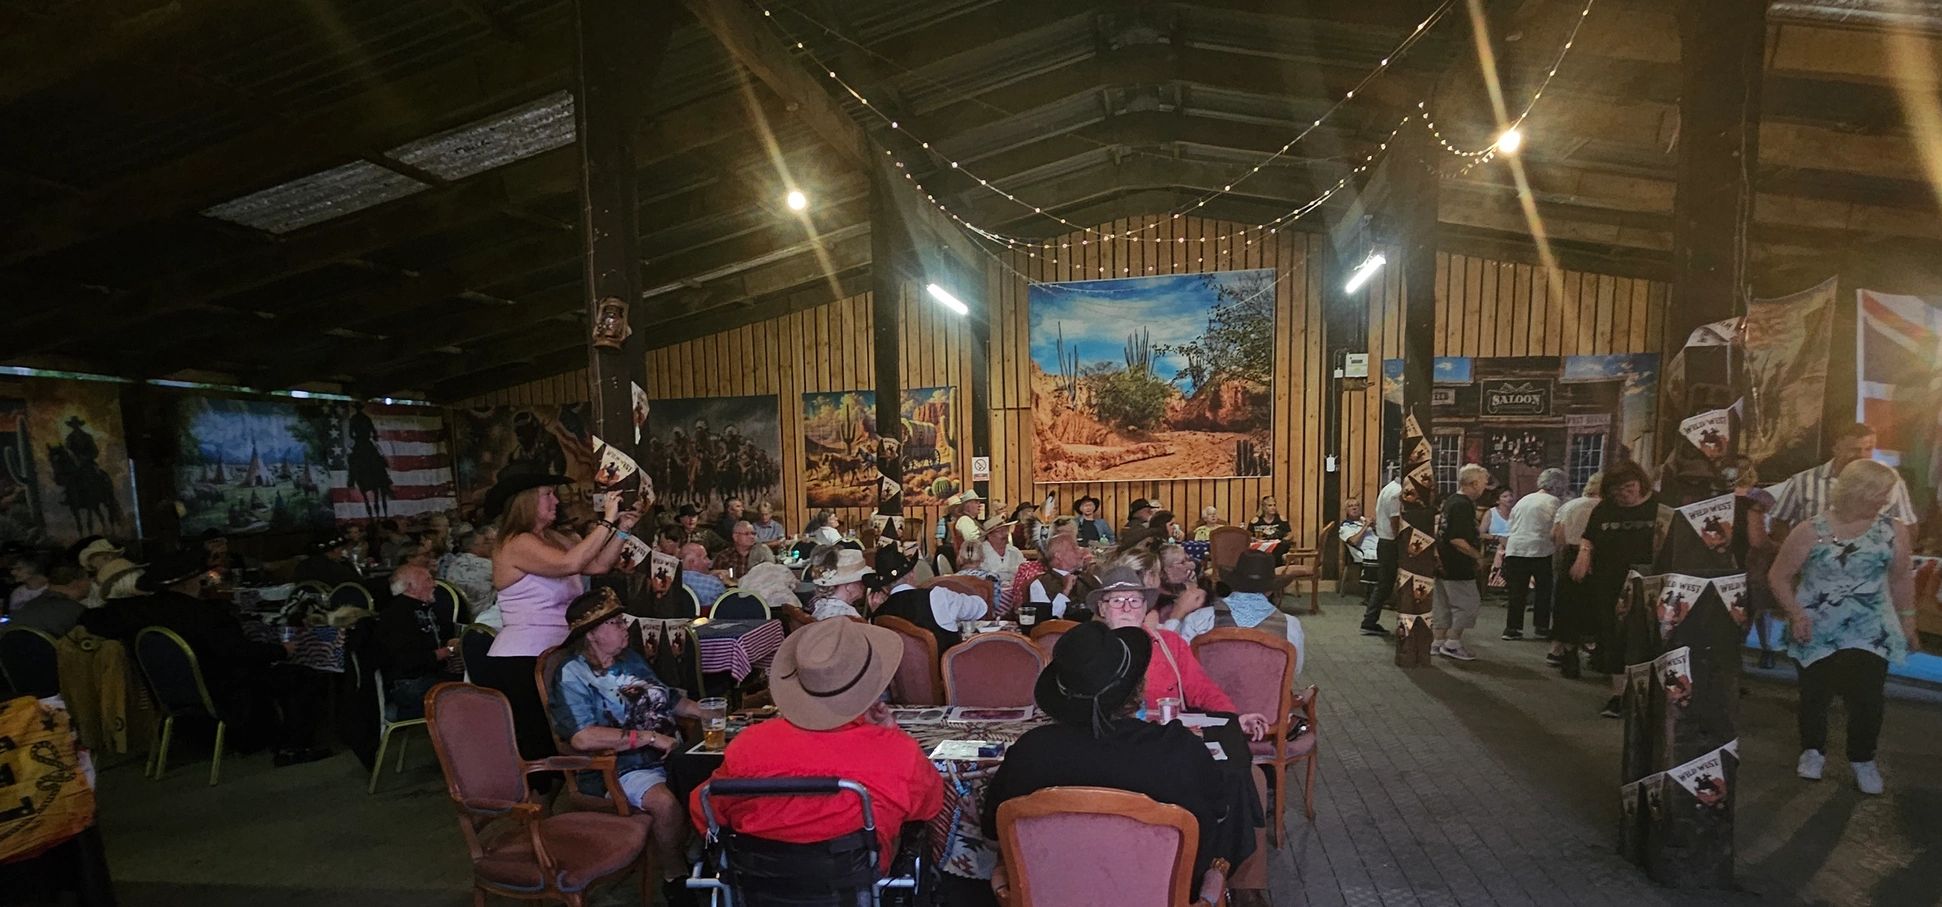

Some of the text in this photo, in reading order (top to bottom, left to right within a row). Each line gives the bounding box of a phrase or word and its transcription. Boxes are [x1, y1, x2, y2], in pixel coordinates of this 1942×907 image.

[1491, 394, 1541, 406] SALOON
[1683, 416, 1728, 434] WILD WEST
[1688, 501, 1732, 520] WILD WEST
[1679, 582, 1702, 594] WEST
[1720, 582, 1741, 593] WILD
[1678, 758, 1719, 782] WILD WEST
